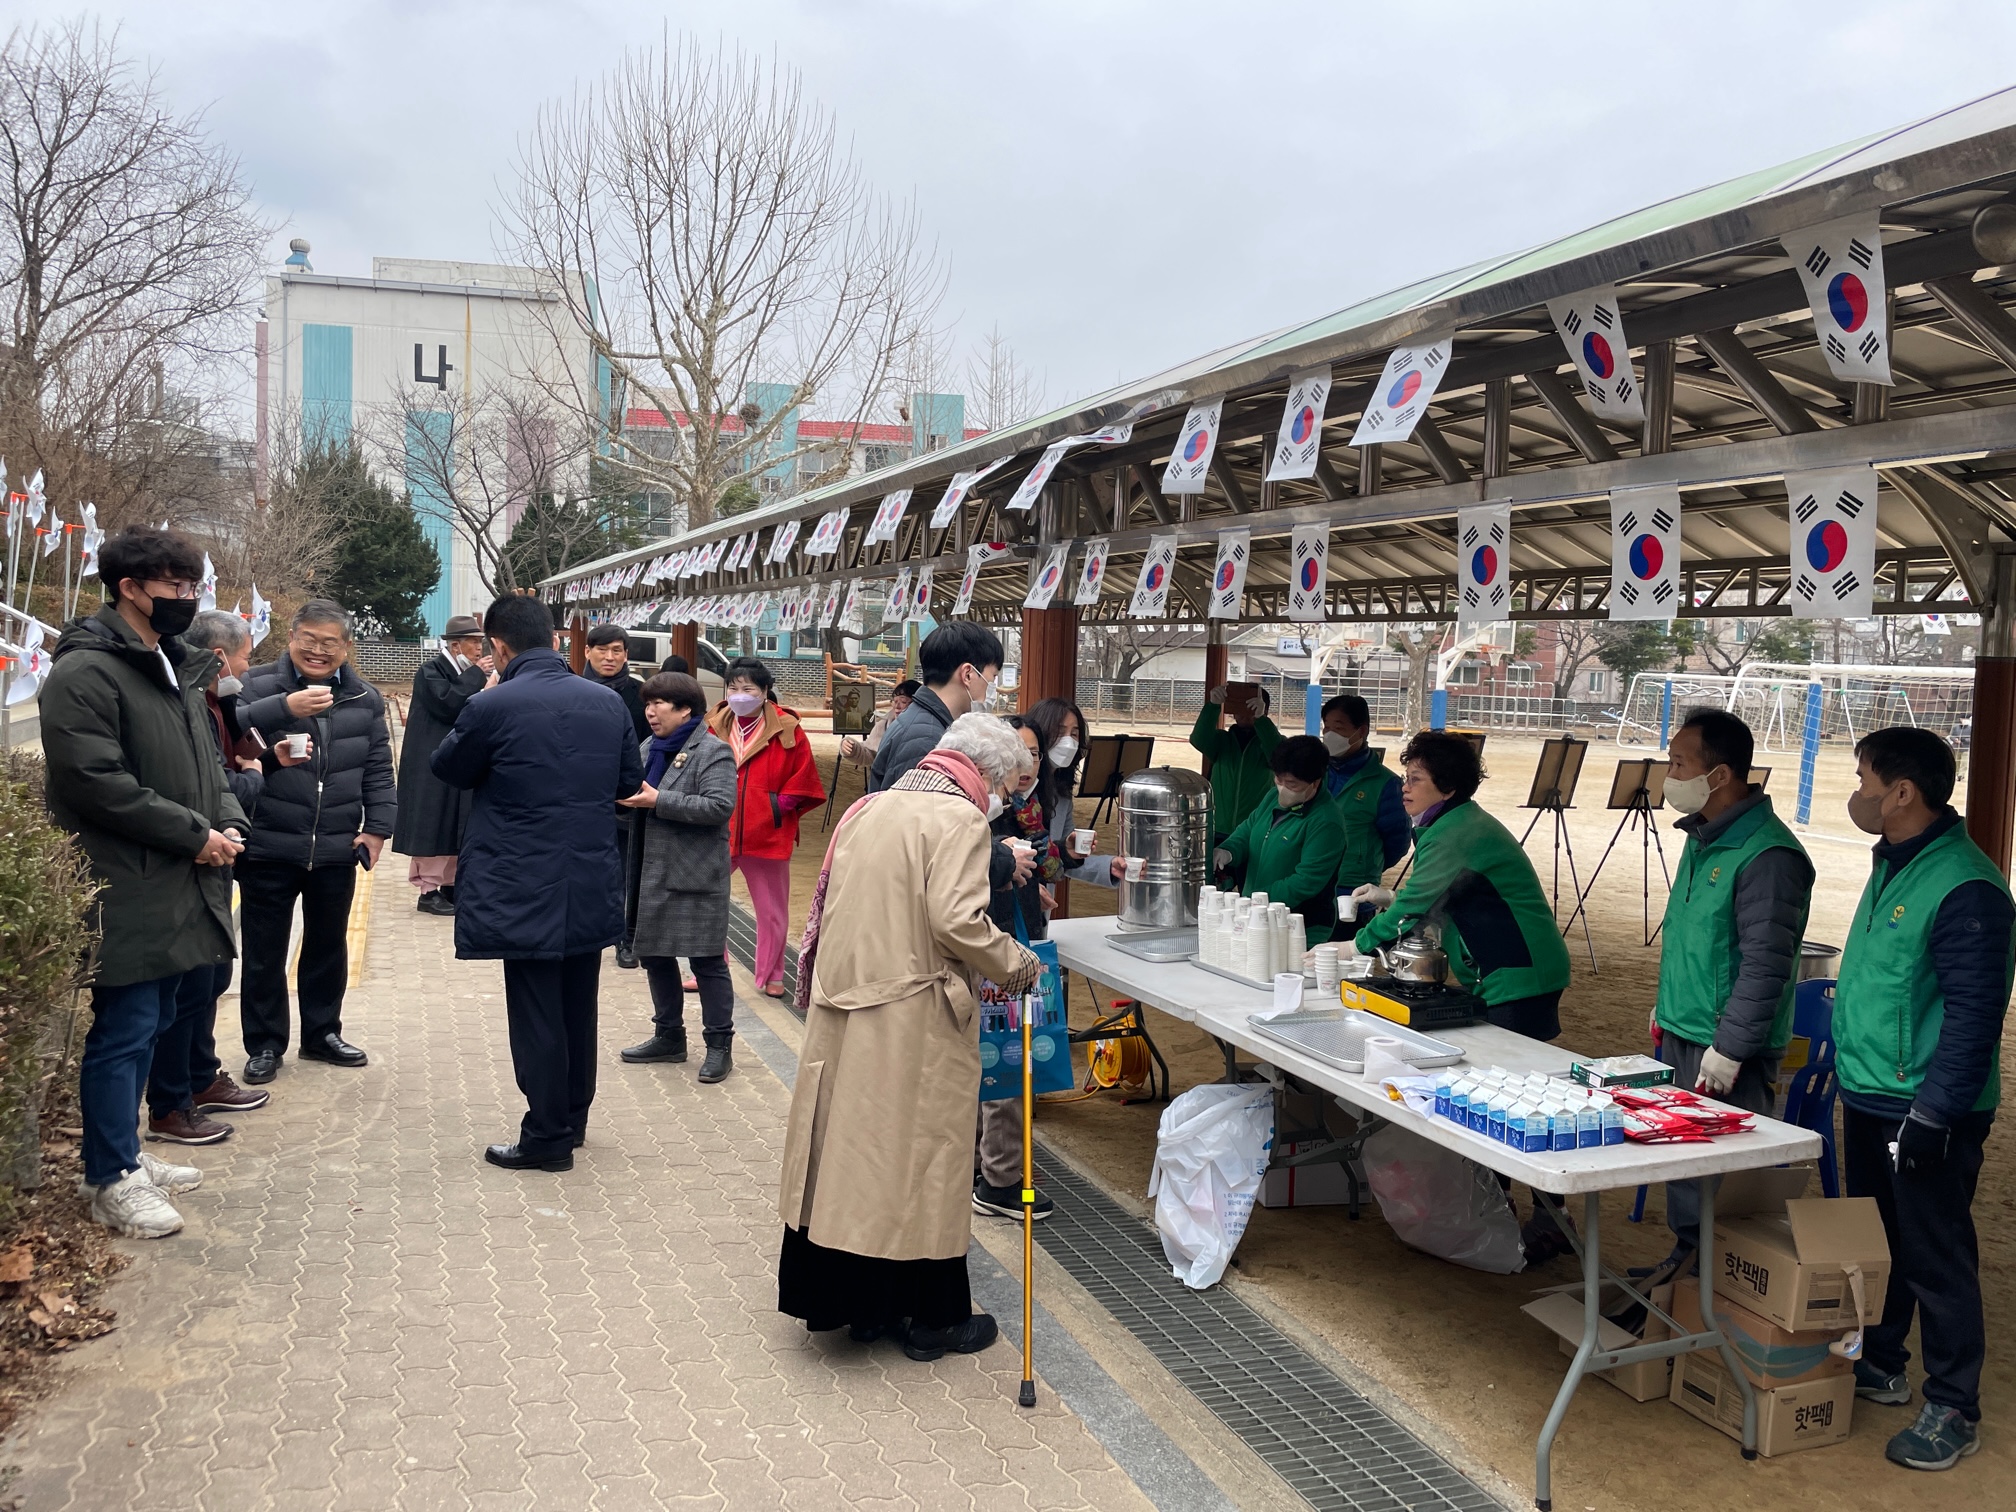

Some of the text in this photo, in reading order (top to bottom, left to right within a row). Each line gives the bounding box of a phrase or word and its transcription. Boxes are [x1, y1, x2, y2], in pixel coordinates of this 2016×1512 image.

[415, 343, 453, 391] 나
[1724, 1251, 1760, 1292] 핫팩
[1794, 1402, 1826, 1432] 핫팩
